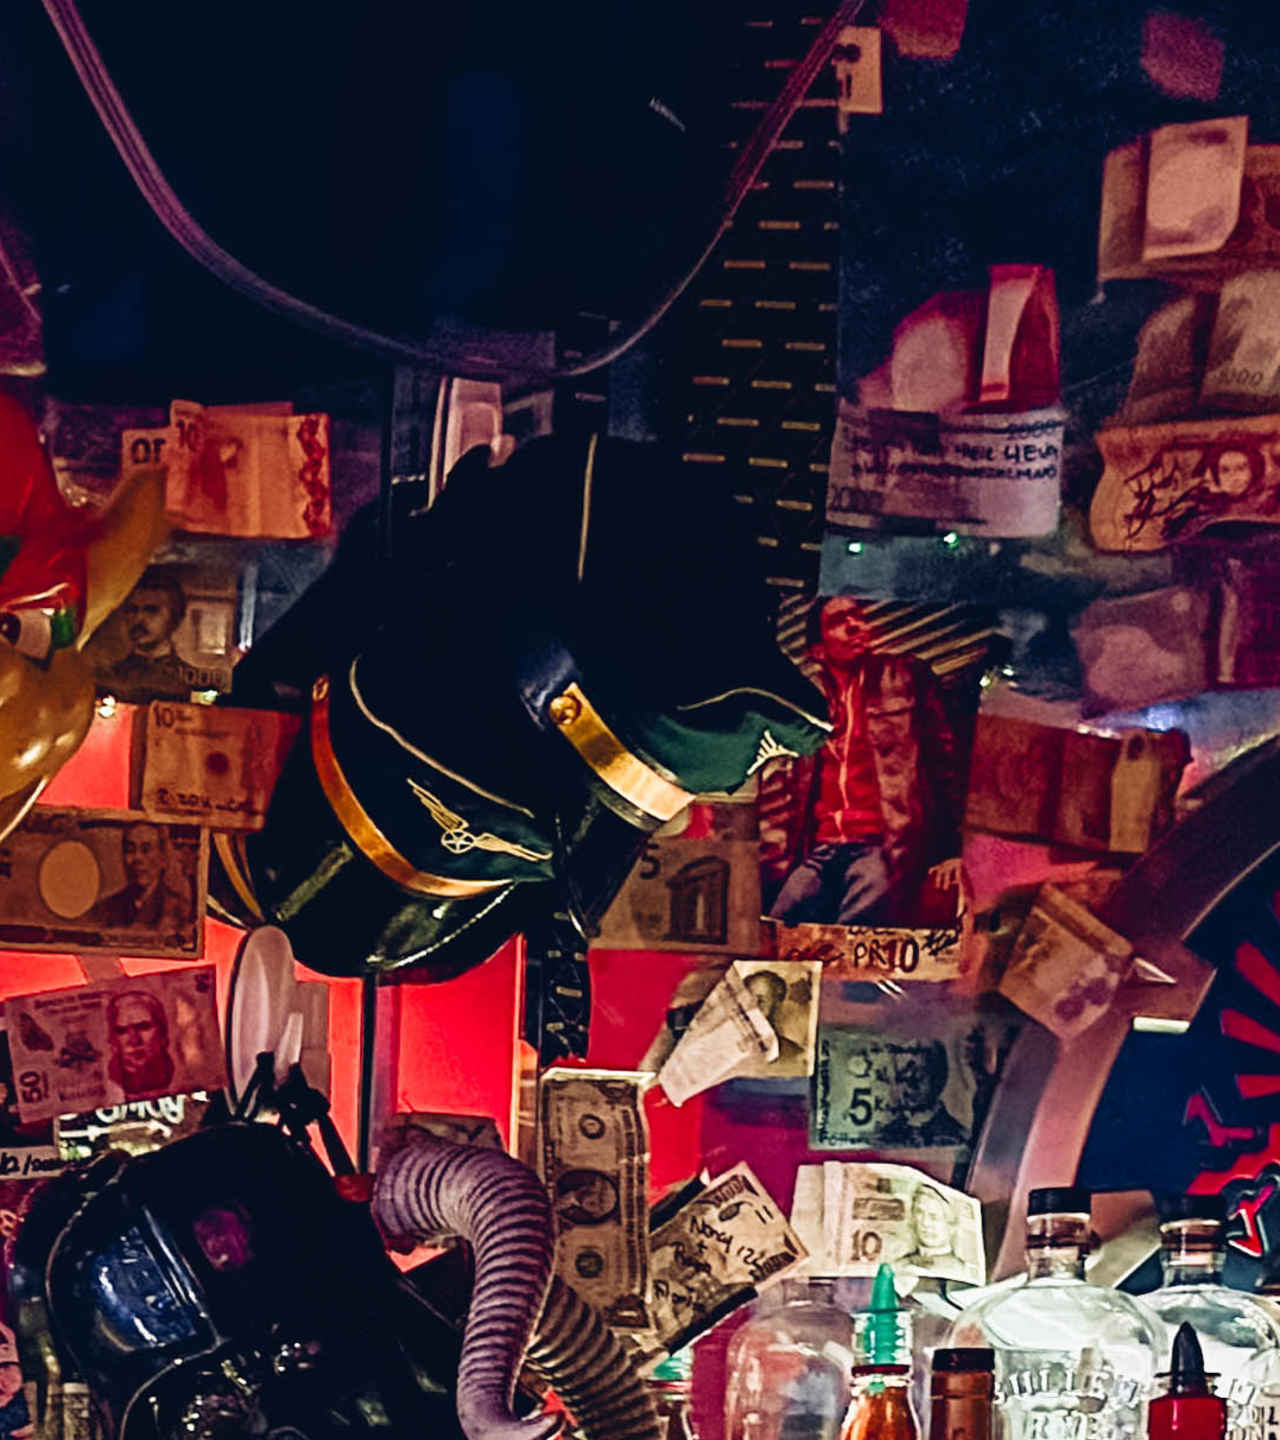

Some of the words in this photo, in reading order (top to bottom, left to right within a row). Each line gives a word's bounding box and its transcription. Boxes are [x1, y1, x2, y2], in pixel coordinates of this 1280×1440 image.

[153, 708, 174, 728] 10
[849, 1087, 872, 1126] 5
[851, 1230, 882, 1262] 10
